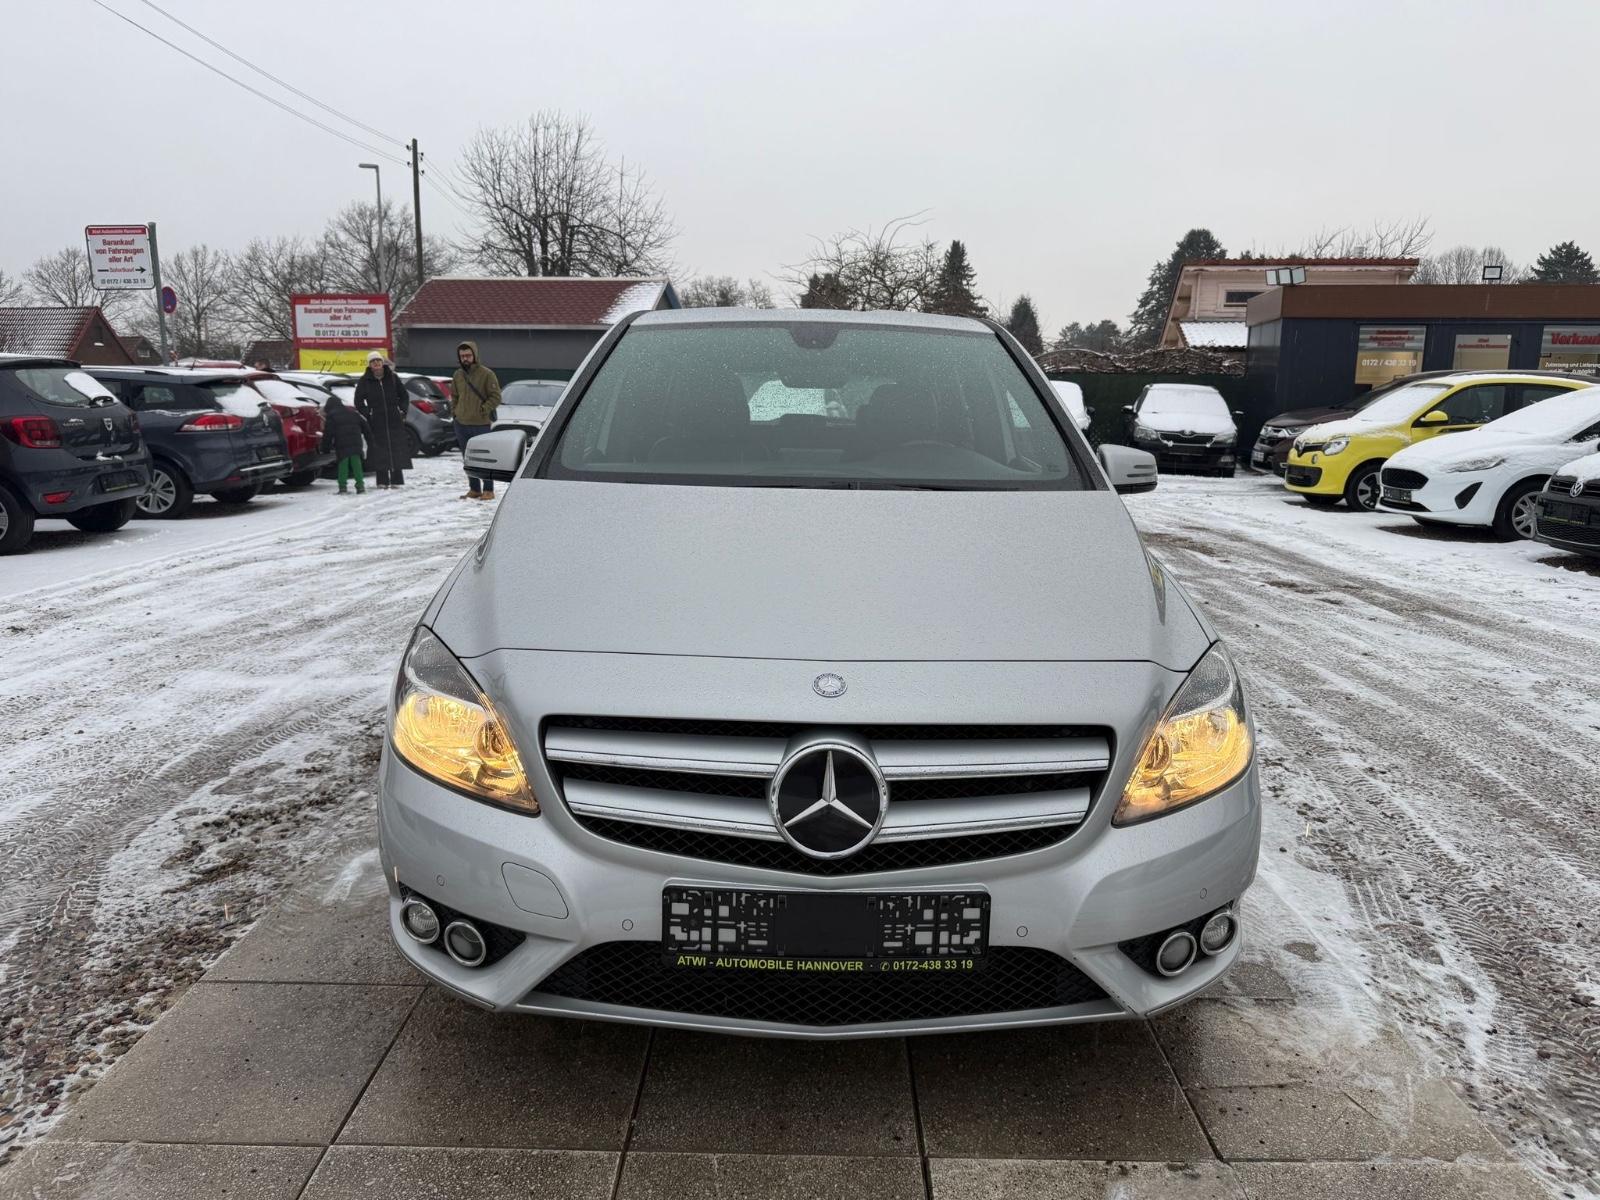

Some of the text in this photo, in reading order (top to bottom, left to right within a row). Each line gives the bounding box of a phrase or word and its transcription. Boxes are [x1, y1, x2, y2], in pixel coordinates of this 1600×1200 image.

[102, 238, 135, 246] Barankauf
[108, 247, 144, 255] Fahrzeugen
[677, 955, 706, 966] ATWI
[716, 958, 794, 970] AUTOMOBILE
[796, 959, 864, 971] HANNOVER
[892, 960, 942, 970] 0172-438
[944, 959, 958, 970] 33
[960, 959, 974, 970] 19
